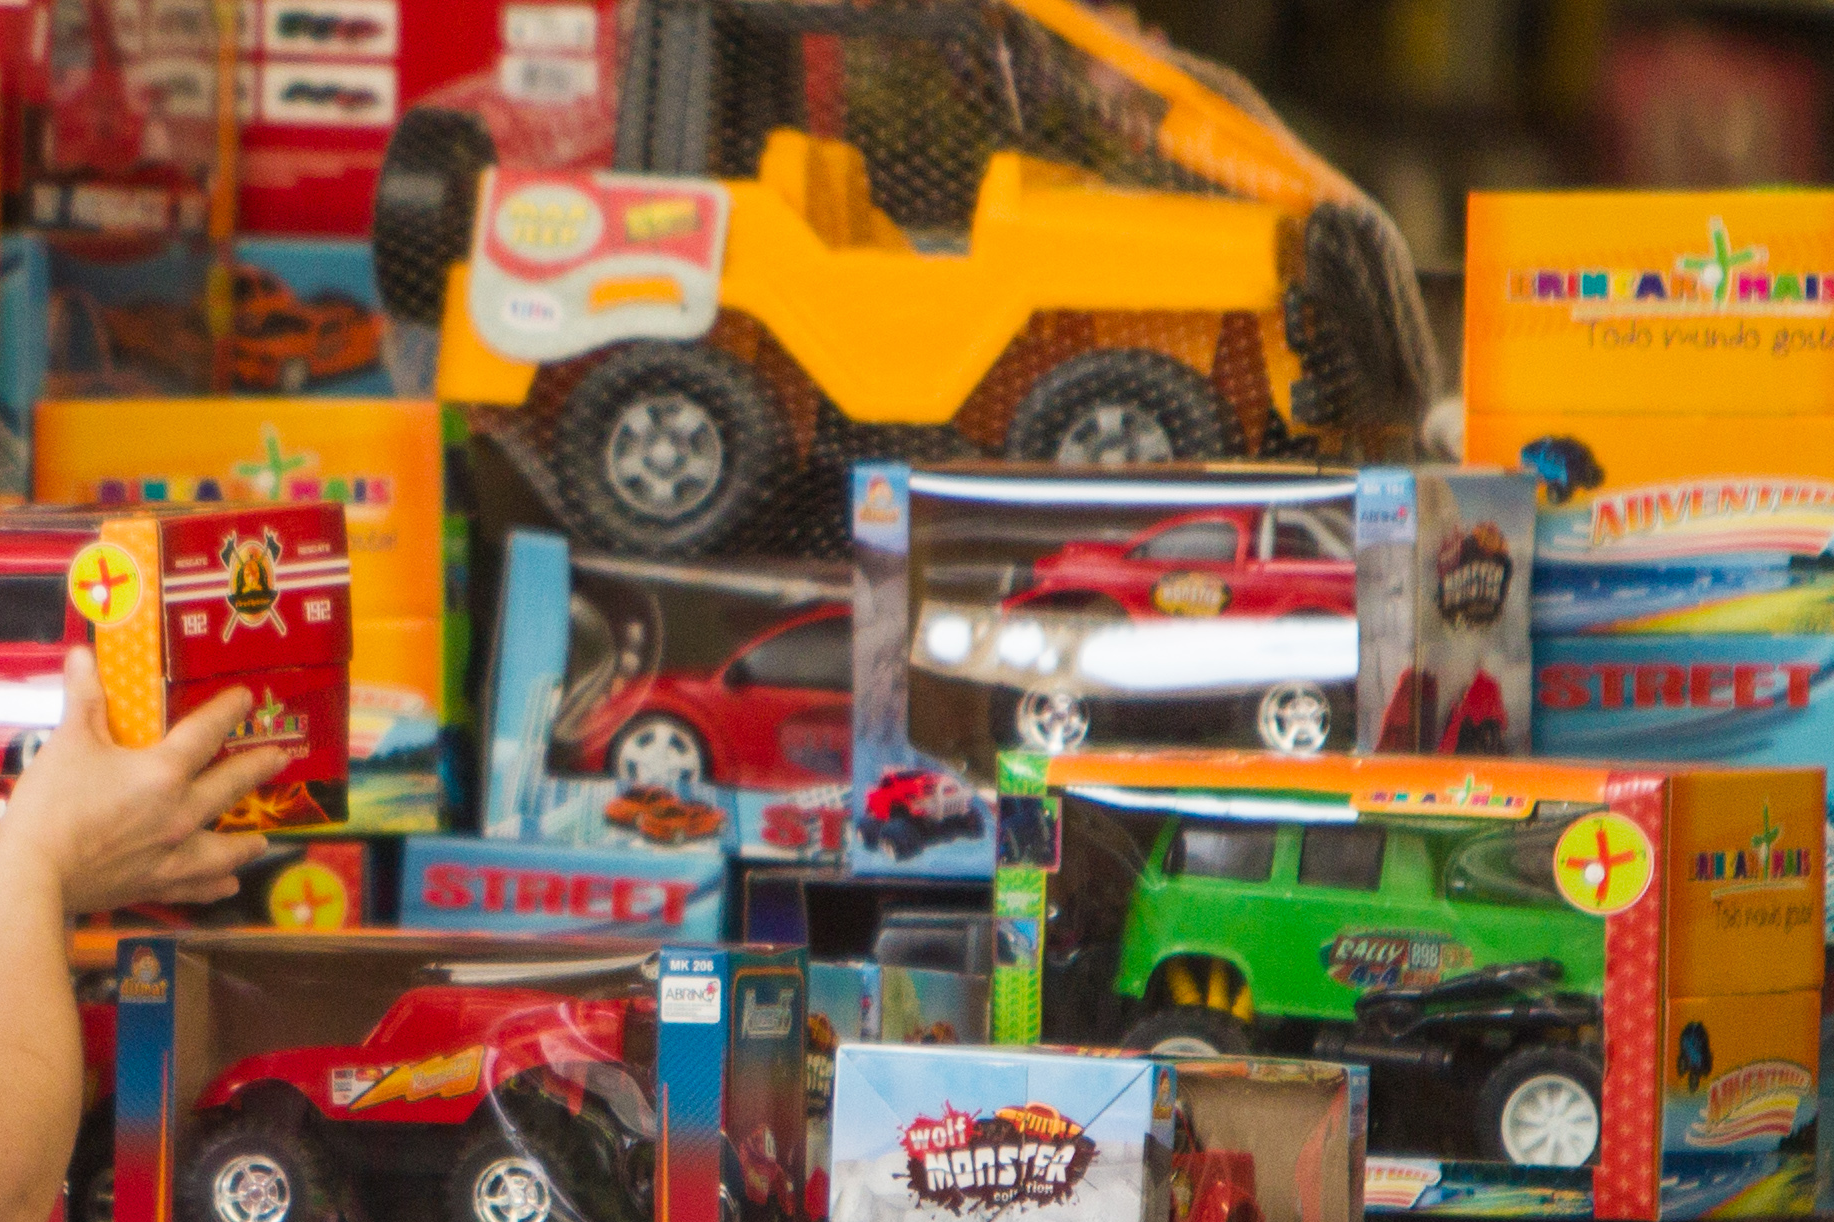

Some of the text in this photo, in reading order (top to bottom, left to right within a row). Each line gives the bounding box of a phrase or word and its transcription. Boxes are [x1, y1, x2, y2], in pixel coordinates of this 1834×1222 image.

[180, 613, 208, 635] 192
[303, 600, 333, 622] 192
[1537, 662, 1821, 710] STREET
[422, 861, 700, 926] STREET
[668, 960, 690, 972] MK
[1335, 938, 1405, 965] RALLY
[908, 1117, 968, 1152] wolf
[922, 1142, 1078, 1193] MONSTER
